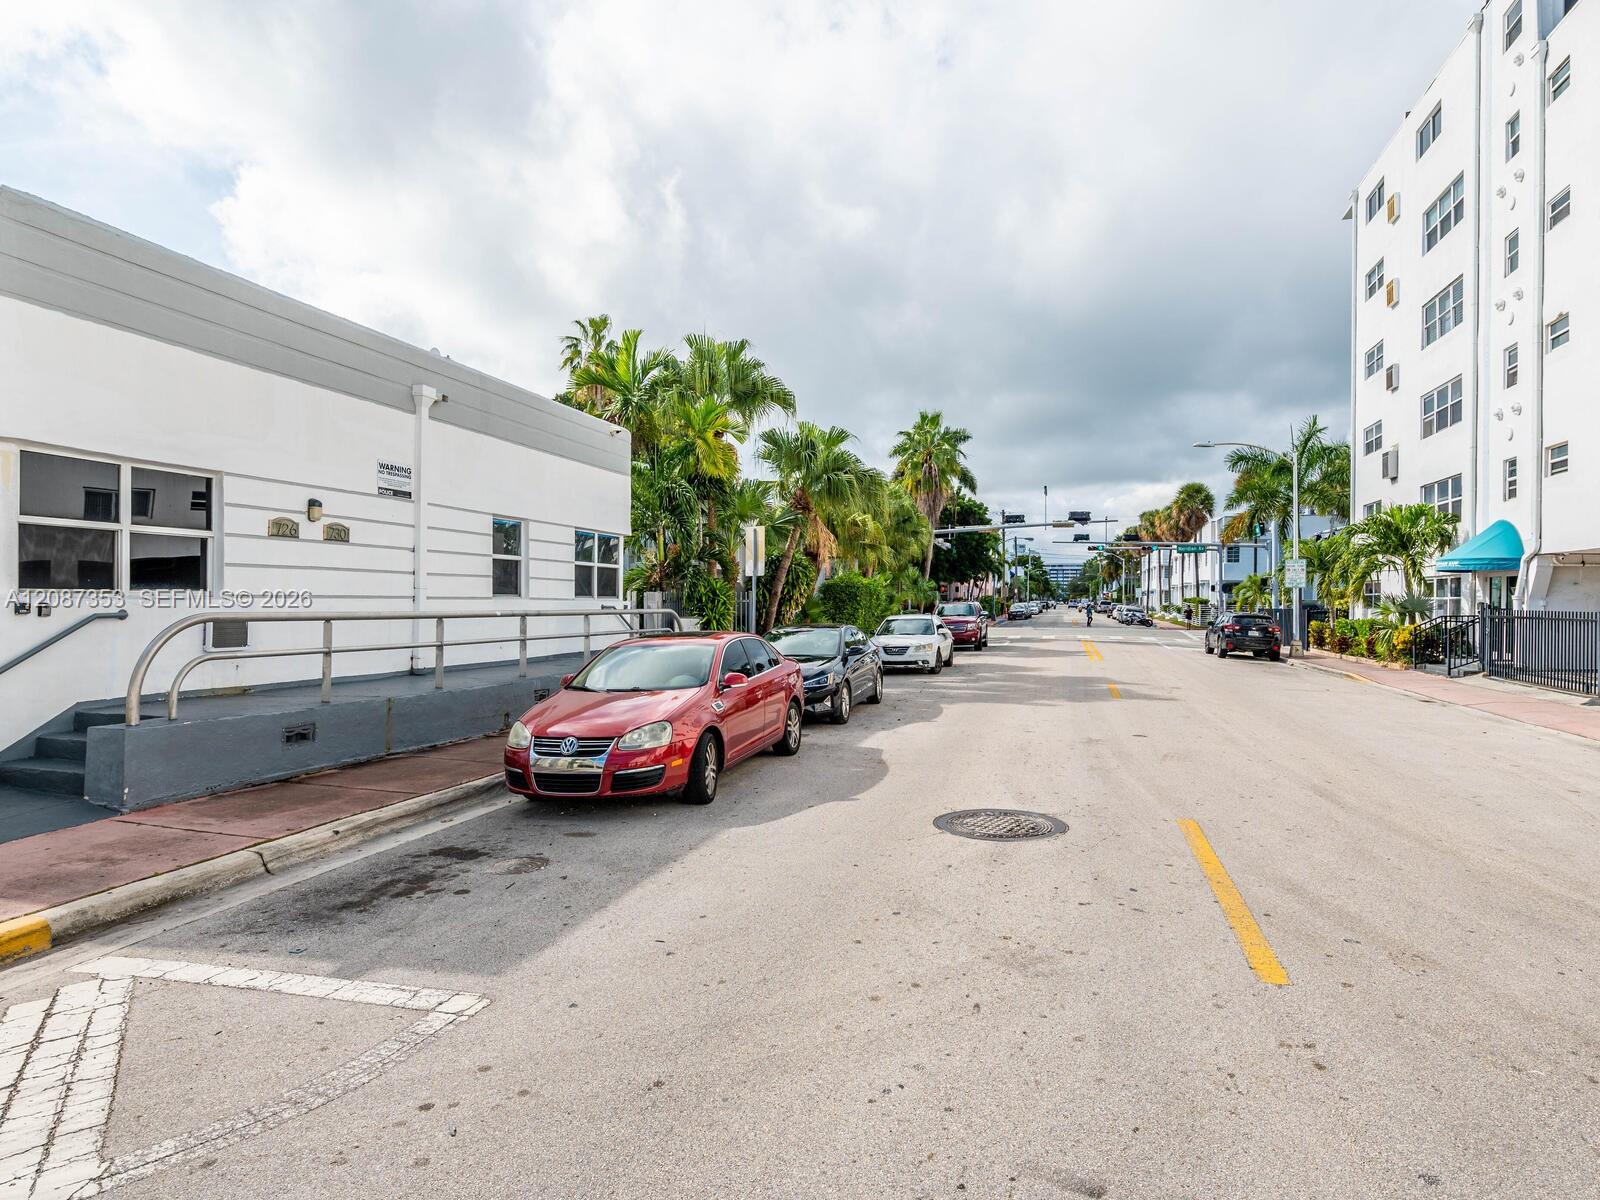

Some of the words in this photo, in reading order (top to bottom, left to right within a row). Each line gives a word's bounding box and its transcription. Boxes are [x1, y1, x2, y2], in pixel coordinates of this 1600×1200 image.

[378, 462, 412, 474] WARNING
[386, 470, 412, 479] TRESPASSING
[275, 522, 297, 536] 726
[329, 527, 347, 540] 730
[561, 737, 577, 755] VW
